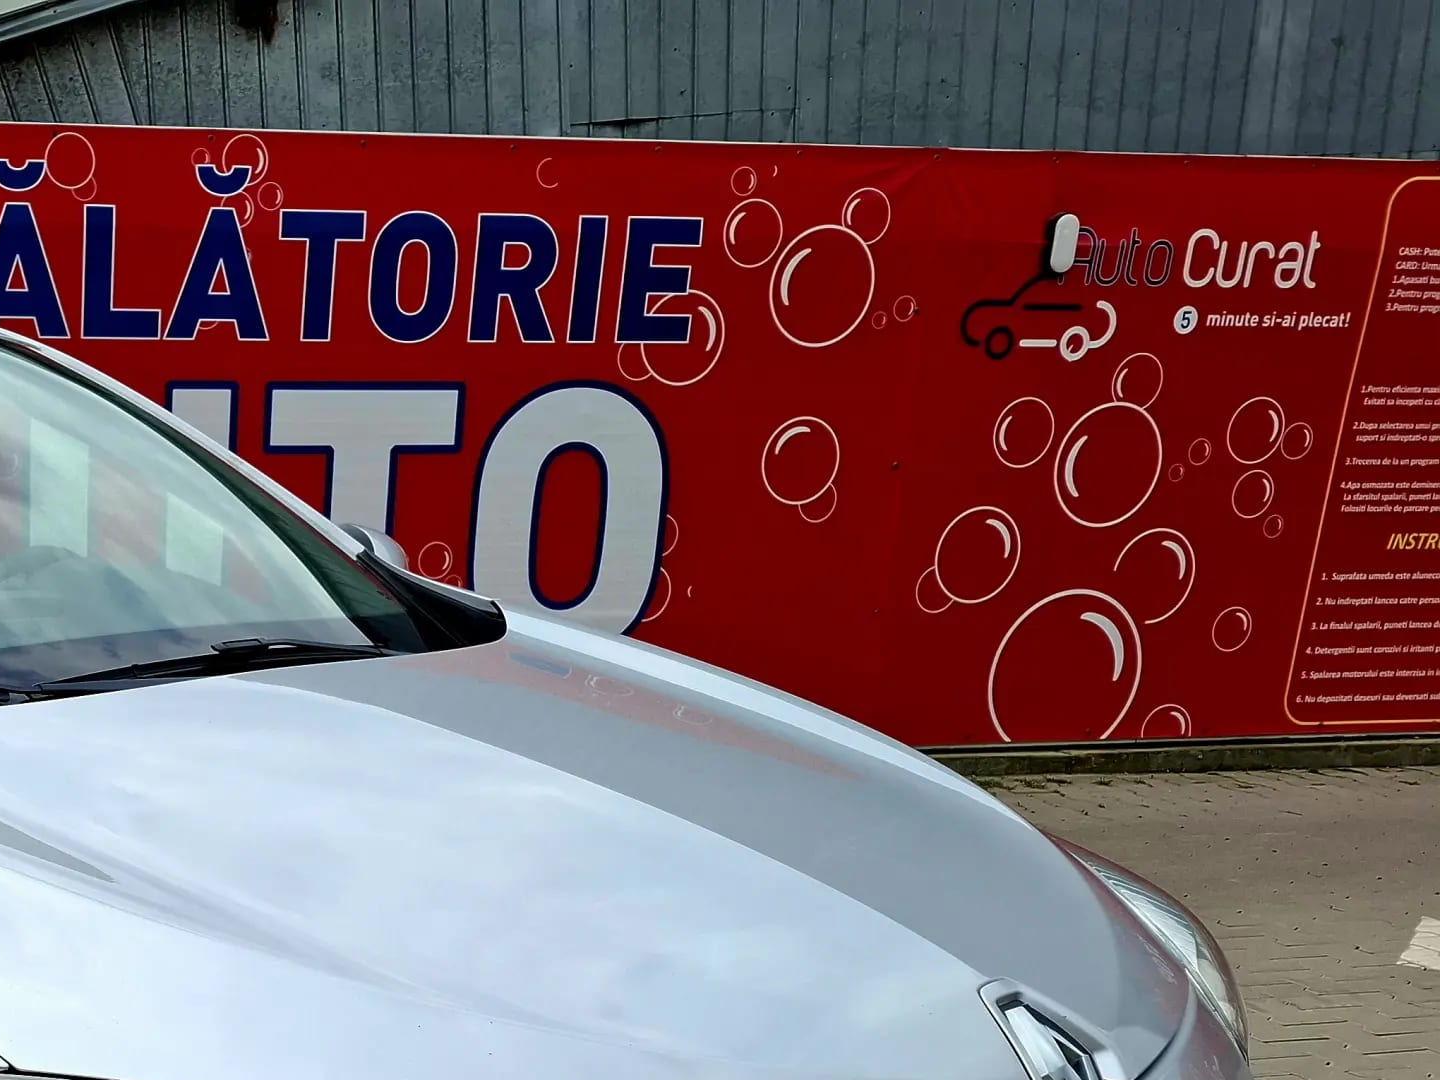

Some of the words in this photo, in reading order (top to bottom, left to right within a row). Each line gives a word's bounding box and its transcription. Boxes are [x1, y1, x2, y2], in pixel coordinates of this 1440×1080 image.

[1183, 228, 1321, 289] Curat
[1179, 311, 1193, 330] 5
[1206, 311, 1259, 327] minute
[1262, 311, 1296, 327] si-ai
[1298, 312, 1351, 331] plecat!
[1386, 532, 1440, 550] INSTR
